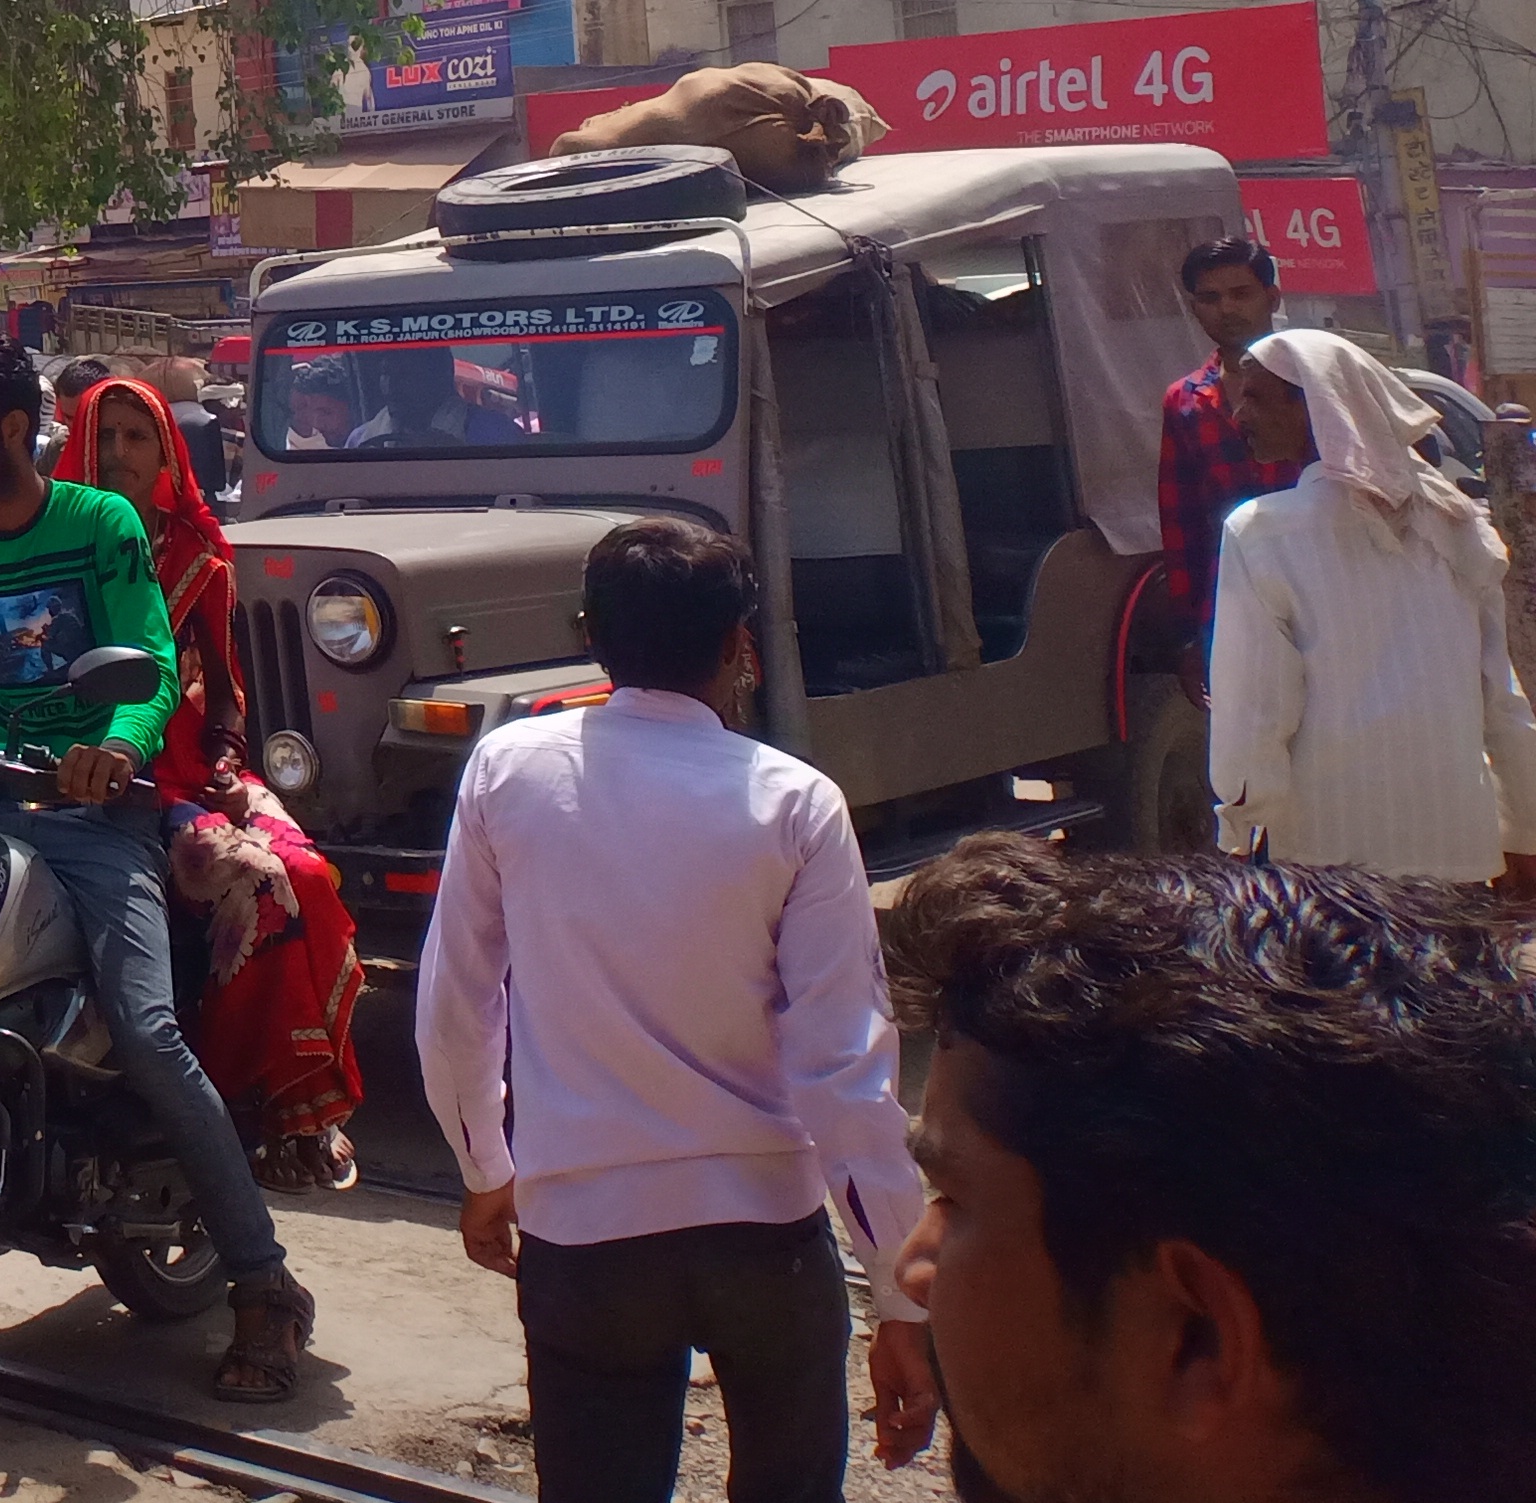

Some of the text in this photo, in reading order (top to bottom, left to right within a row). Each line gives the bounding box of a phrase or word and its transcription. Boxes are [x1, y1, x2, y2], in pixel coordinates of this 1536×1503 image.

[439, 27, 456, 38] TOH
[456, 24, 478, 35] APNE
[386, 61, 444, 89] LUX
[967, 46, 1214, 119] airtel 4G
[382, 109, 434, 126] GENERAL
[437, 104, 476, 120] STORE
[1018, 120, 1215, 144] THE SMARTPHONE NETWORK
[1287, 207, 1342, 248] 4G
[336, 305, 646, 337] K.S.MOTORS LTD.
[361, 334, 393, 344] ROAD
